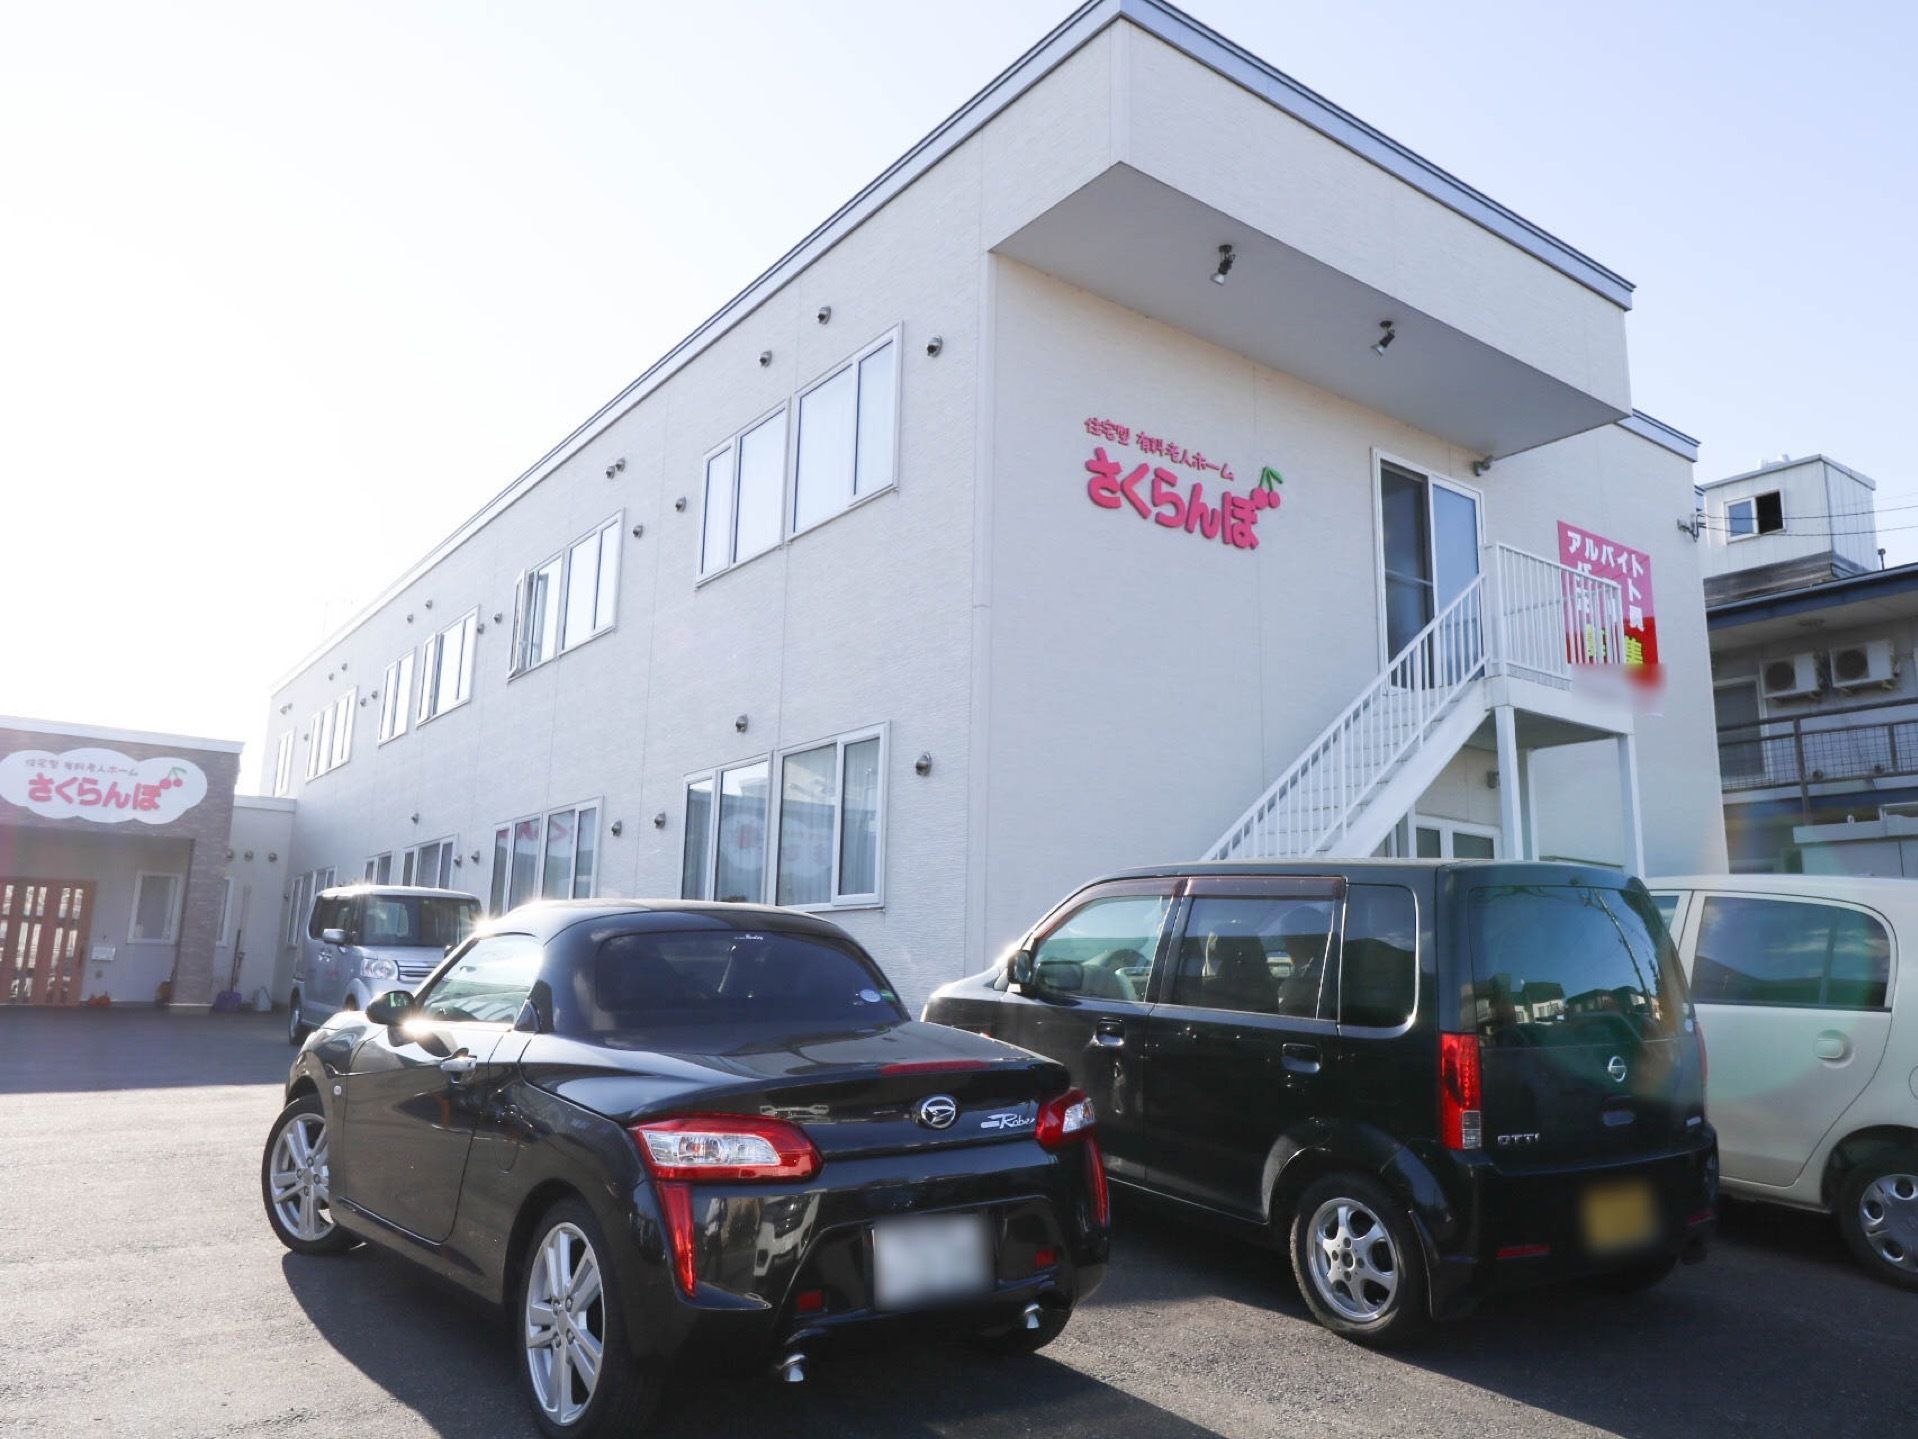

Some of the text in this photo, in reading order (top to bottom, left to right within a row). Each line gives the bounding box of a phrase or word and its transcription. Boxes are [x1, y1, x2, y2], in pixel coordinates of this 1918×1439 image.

[1084, 417, 1234, 481] 住宅型 有料老人ホーム
[1085, 447, 1281, 550] さくらんぼ
[1567, 530, 1644, 579] アルバイト
[28, 772, 184, 811] さくらんぼ
